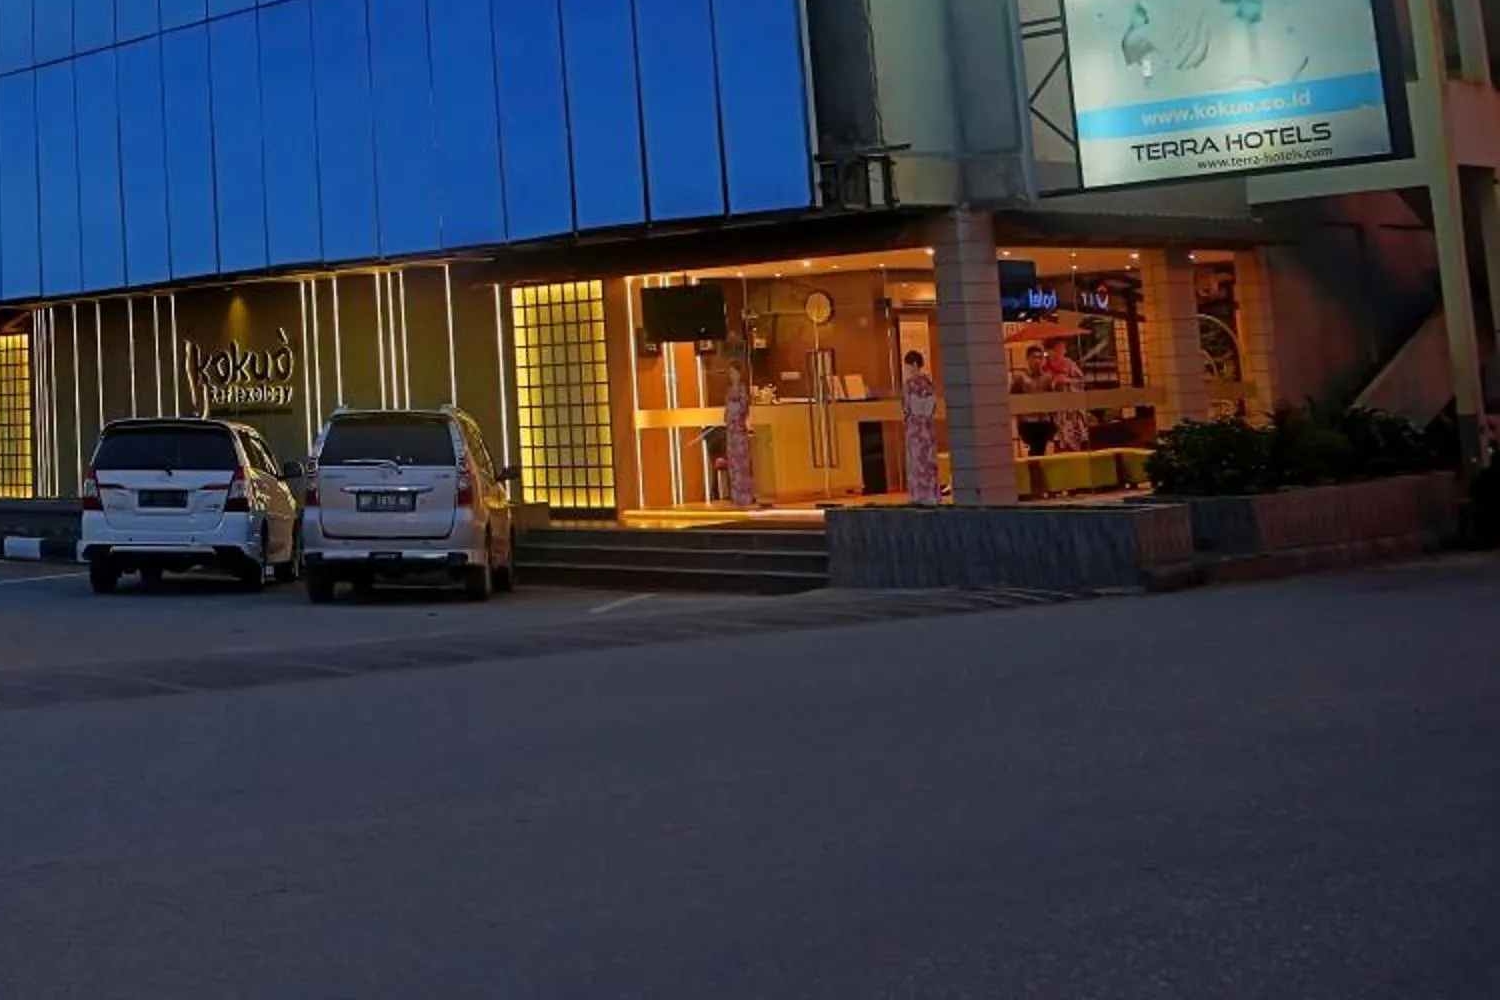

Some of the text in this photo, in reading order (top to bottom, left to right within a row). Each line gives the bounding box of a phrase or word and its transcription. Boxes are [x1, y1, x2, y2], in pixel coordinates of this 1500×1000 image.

[1131, 122, 1332, 162] TERRA HOTELS
[1197, 147, 1333, 170] www.terra-hotels.com
